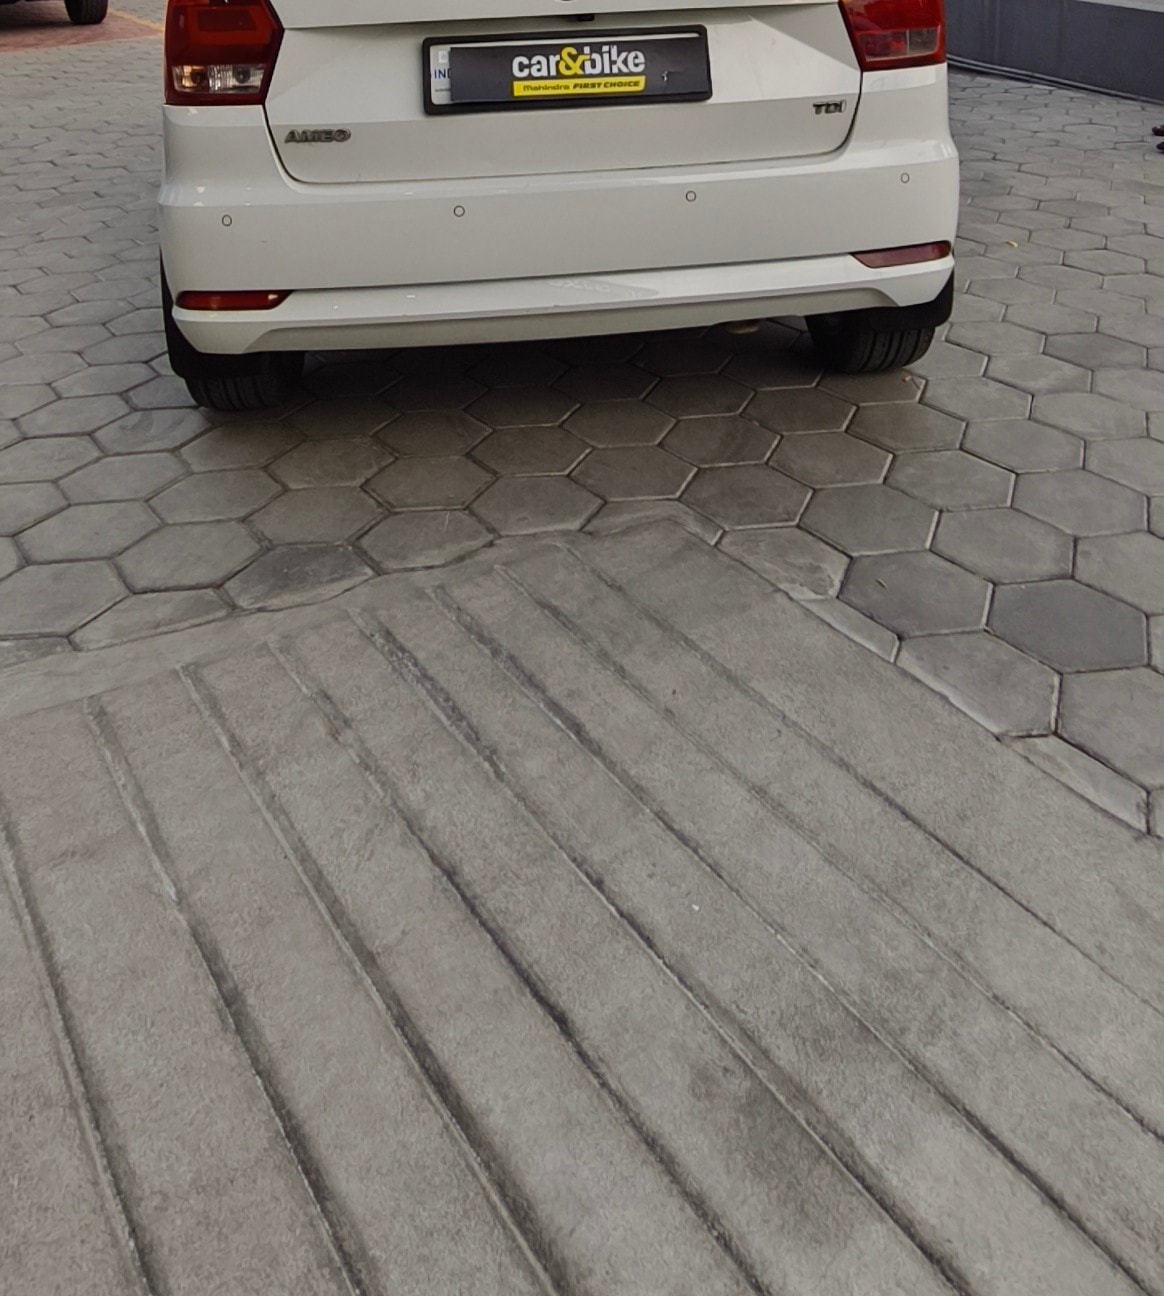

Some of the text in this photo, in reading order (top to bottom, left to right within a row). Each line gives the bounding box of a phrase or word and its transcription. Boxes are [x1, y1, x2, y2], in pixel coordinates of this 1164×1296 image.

[512, 45, 645, 78] car&bike
[573, 82, 603, 90] FIRST
[604, 80, 640, 89] CHOICE
[284, 129, 351, 143] AMEO
